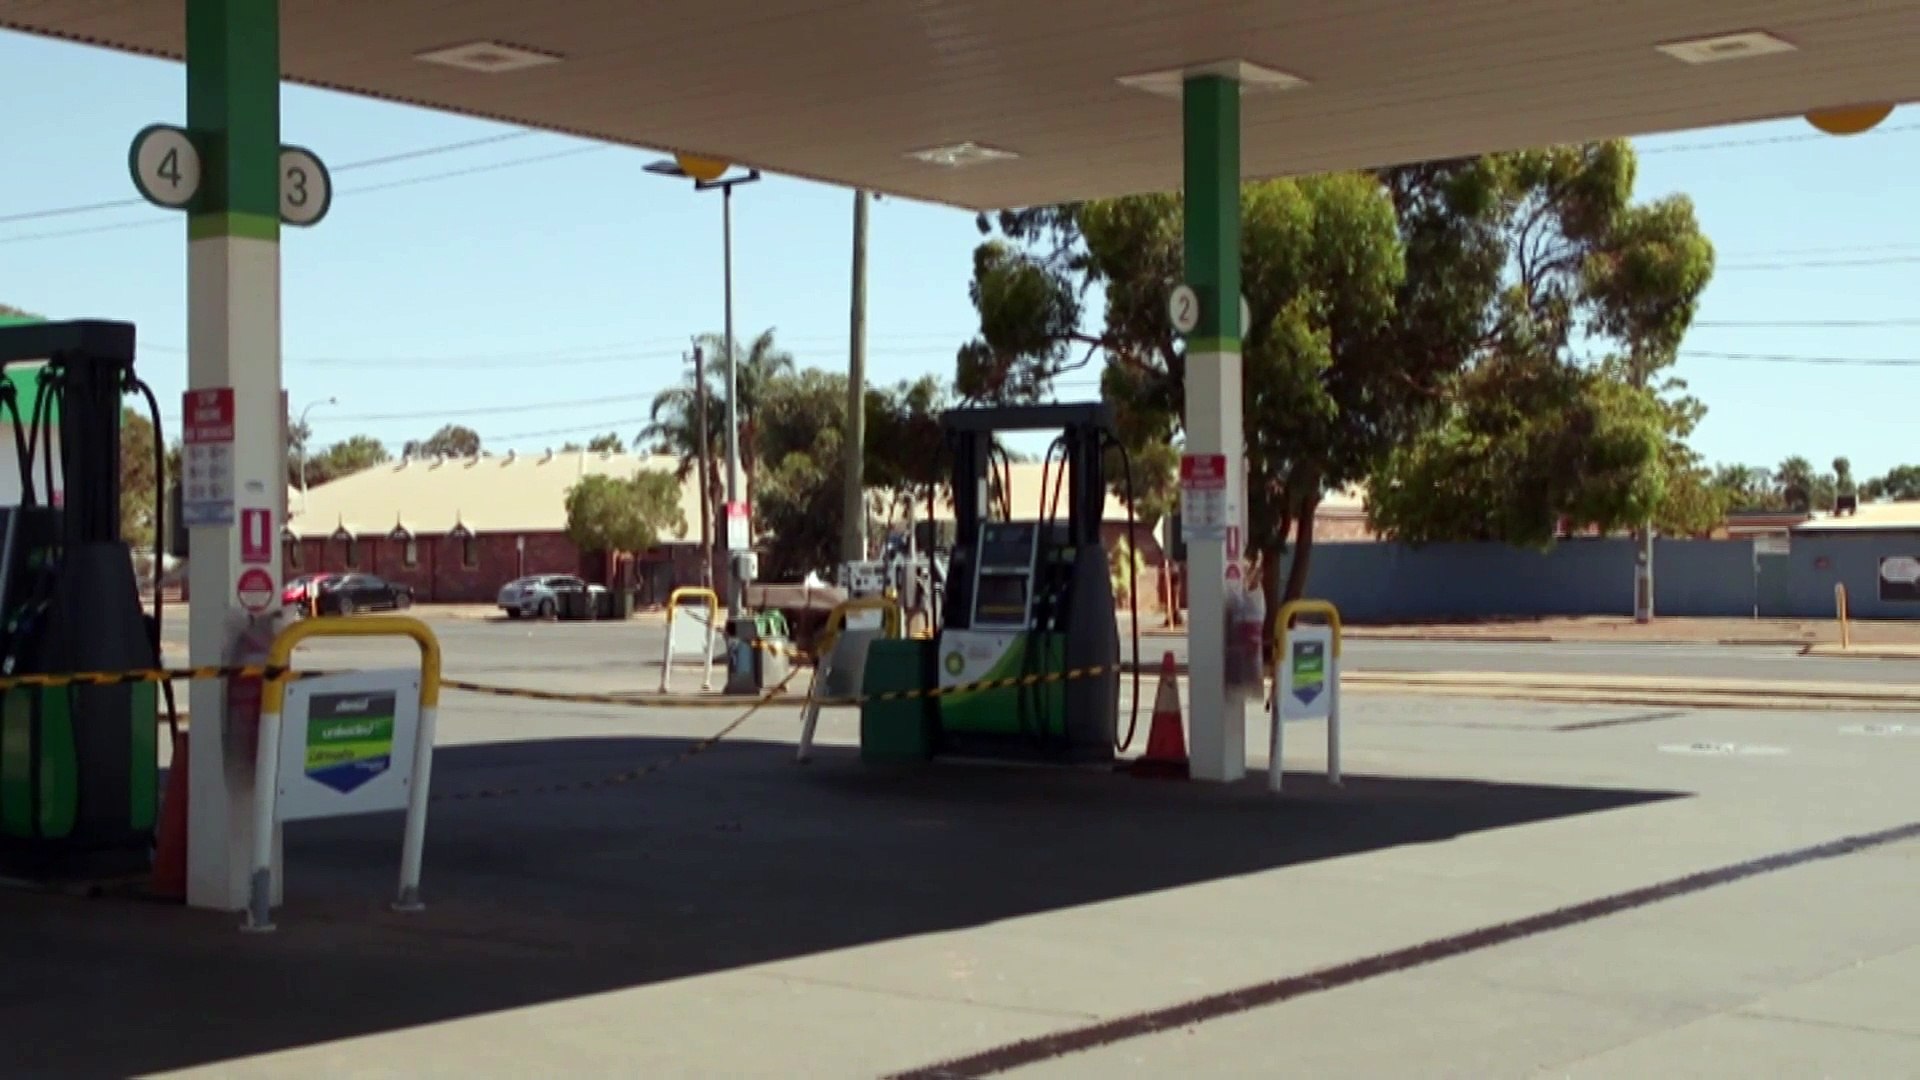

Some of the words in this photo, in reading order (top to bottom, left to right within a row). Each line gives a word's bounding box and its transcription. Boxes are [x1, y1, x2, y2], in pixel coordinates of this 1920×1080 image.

[156, 147, 181, 188] 4
[286, 166, 307, 207] 3
[1179, 294, 1190, 323] 2
